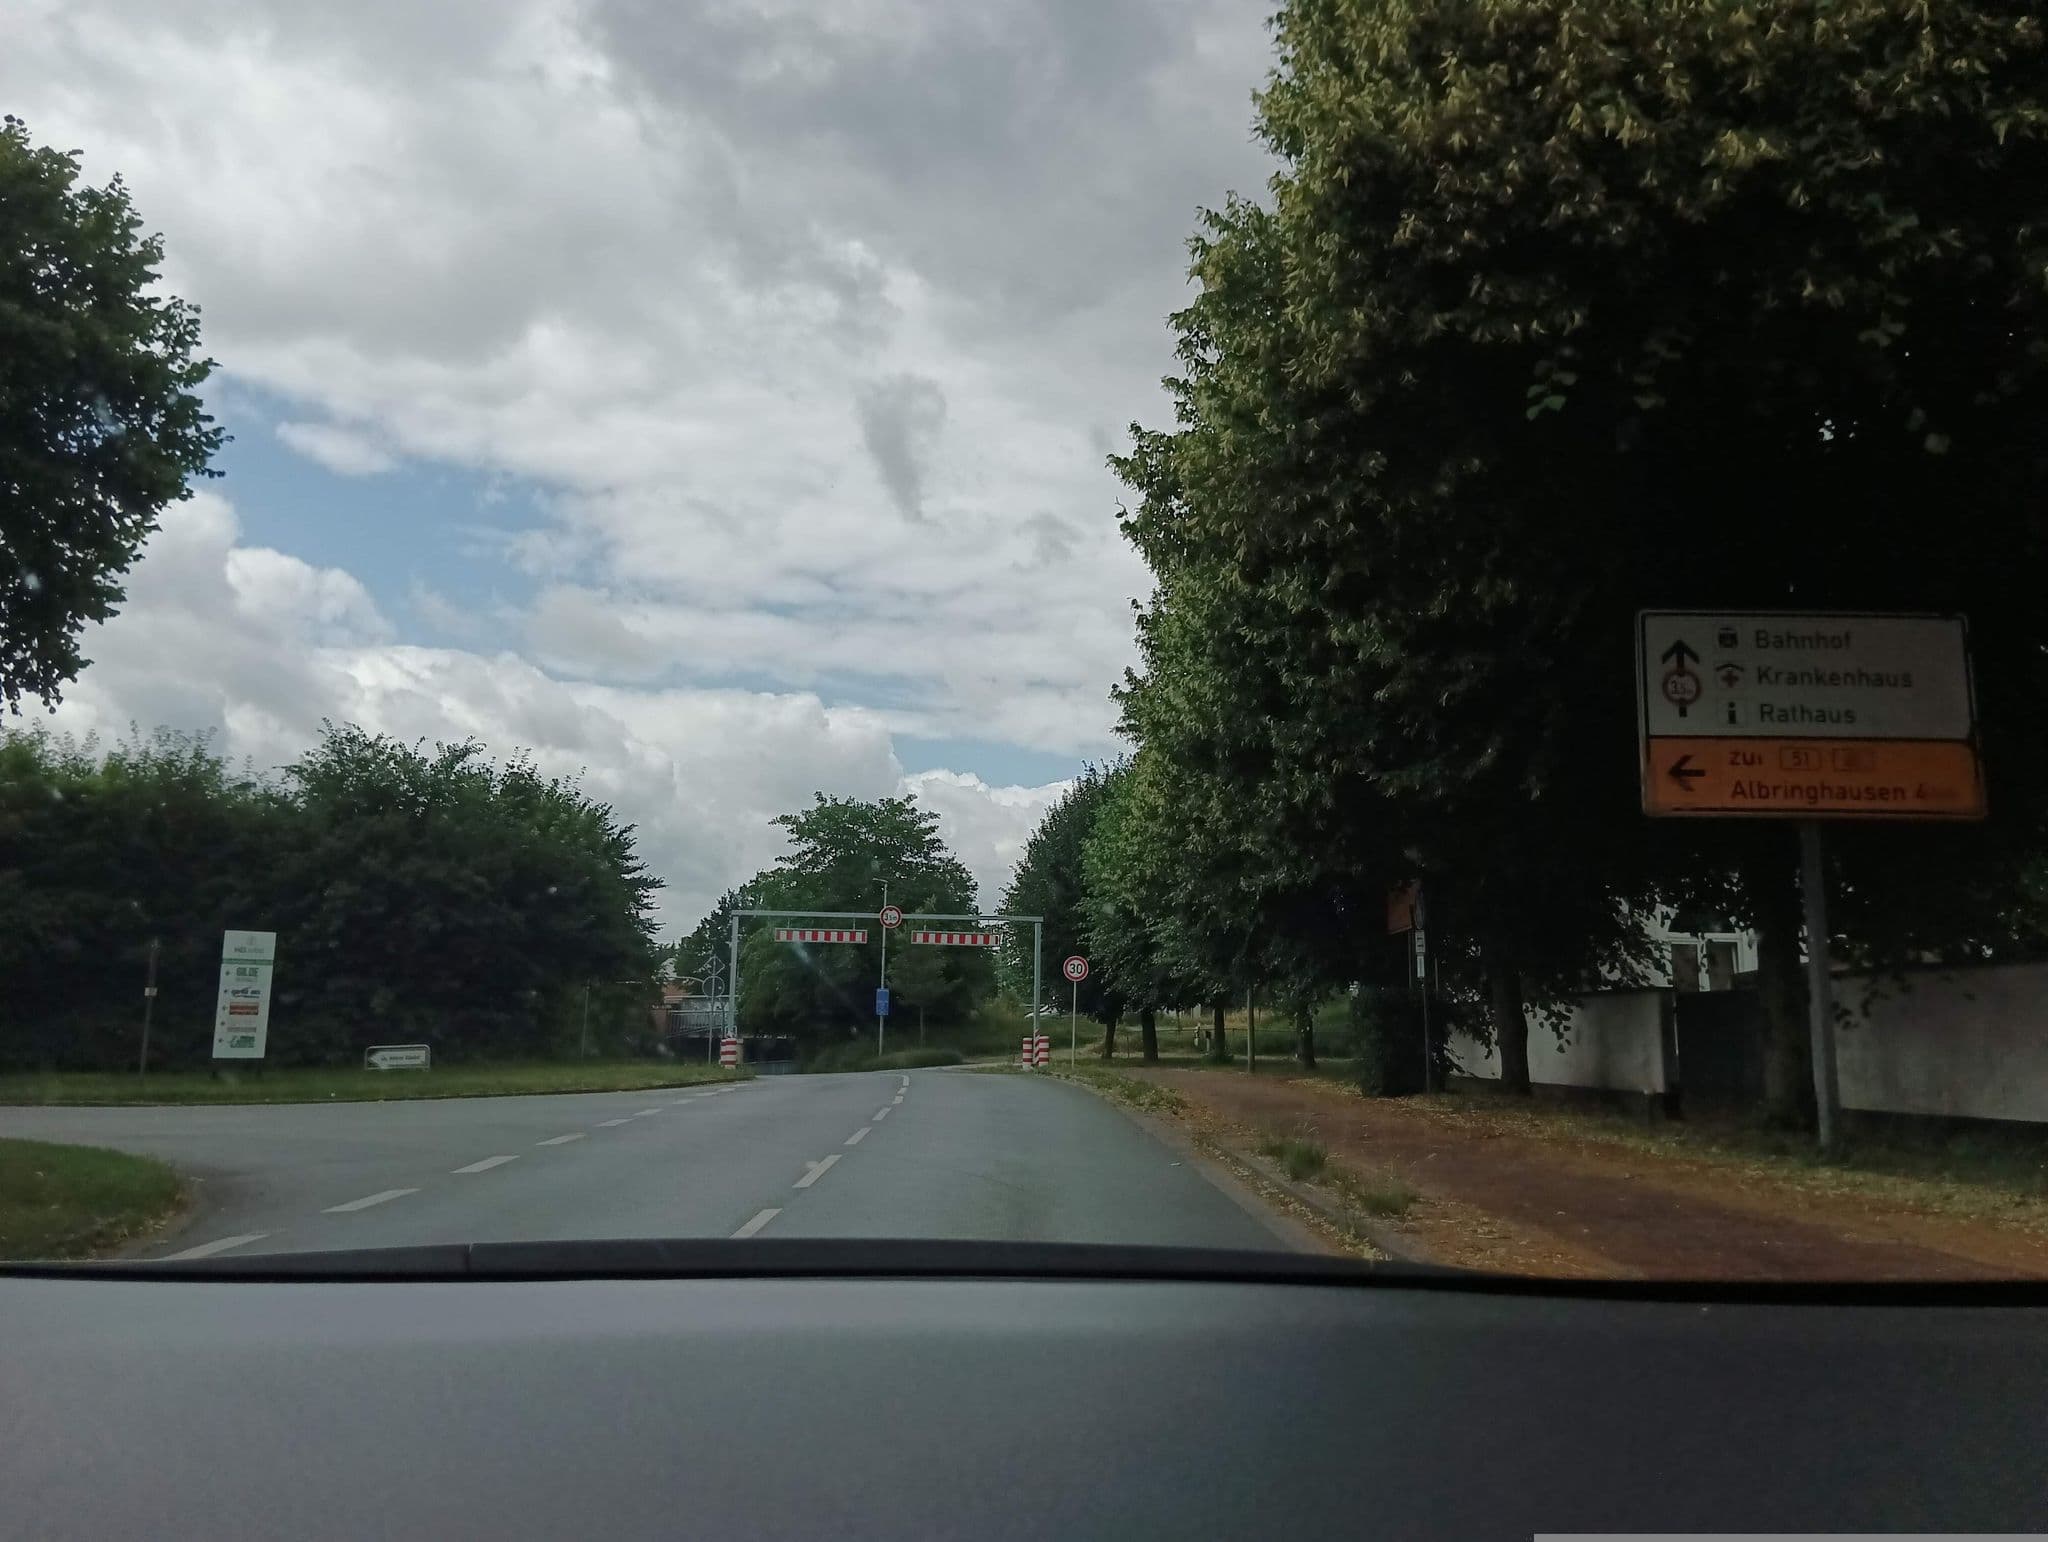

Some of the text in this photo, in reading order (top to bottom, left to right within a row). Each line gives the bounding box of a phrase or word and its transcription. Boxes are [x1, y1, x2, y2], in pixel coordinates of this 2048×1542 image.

[1755, 629, 1852, 650] Bahnhof
[1757, 666, 1913, 688] Krankenhaus
[1760, 703, 1857, 724] Rathaus
[1730, 779, 1906, 805] Albringhausen
[1069, 963, 1083, 975] 30
